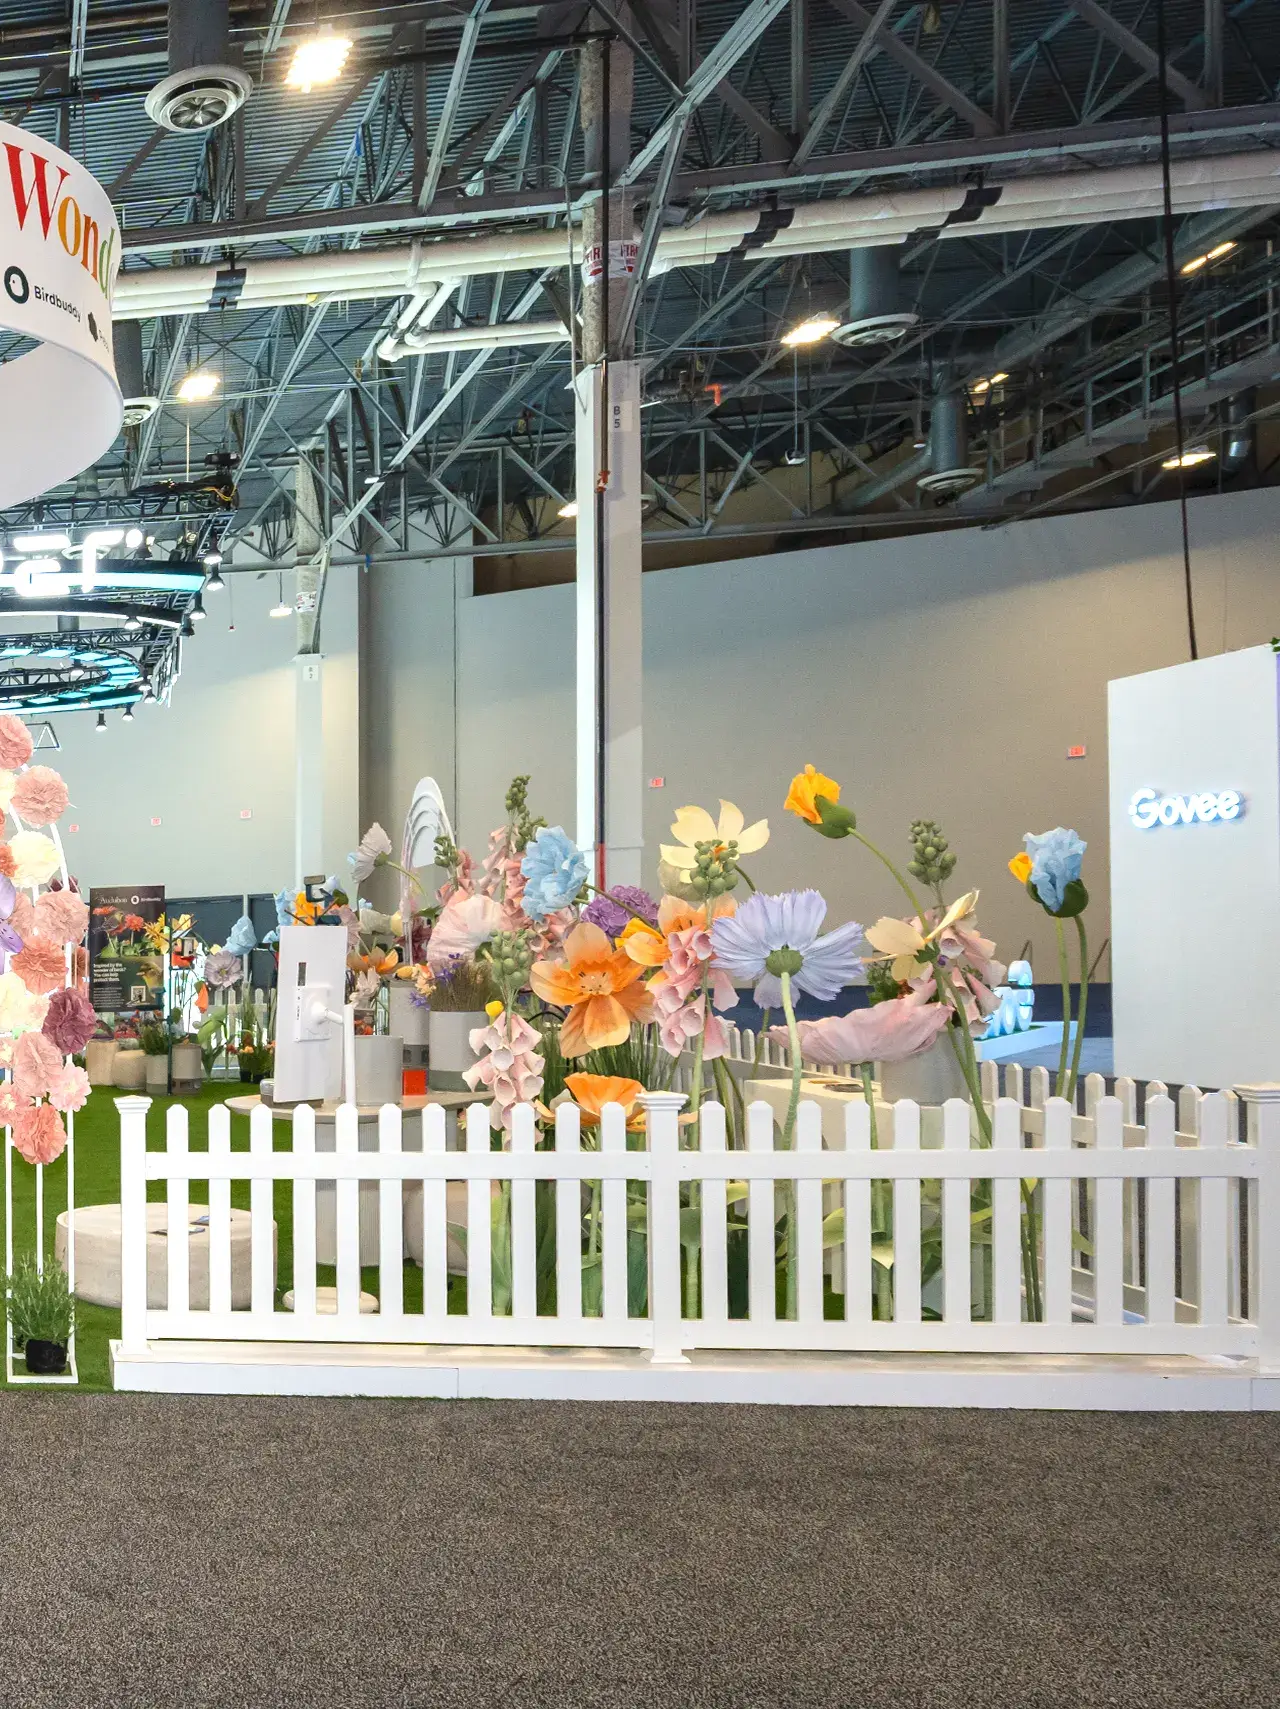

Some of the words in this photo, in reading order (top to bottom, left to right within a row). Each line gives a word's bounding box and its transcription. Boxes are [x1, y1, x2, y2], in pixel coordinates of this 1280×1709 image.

[2, 142, 114, 312] Wond
[34, 285, 81, 323] Birdbuddy
[1128, 787, 1240, 828] Govee
